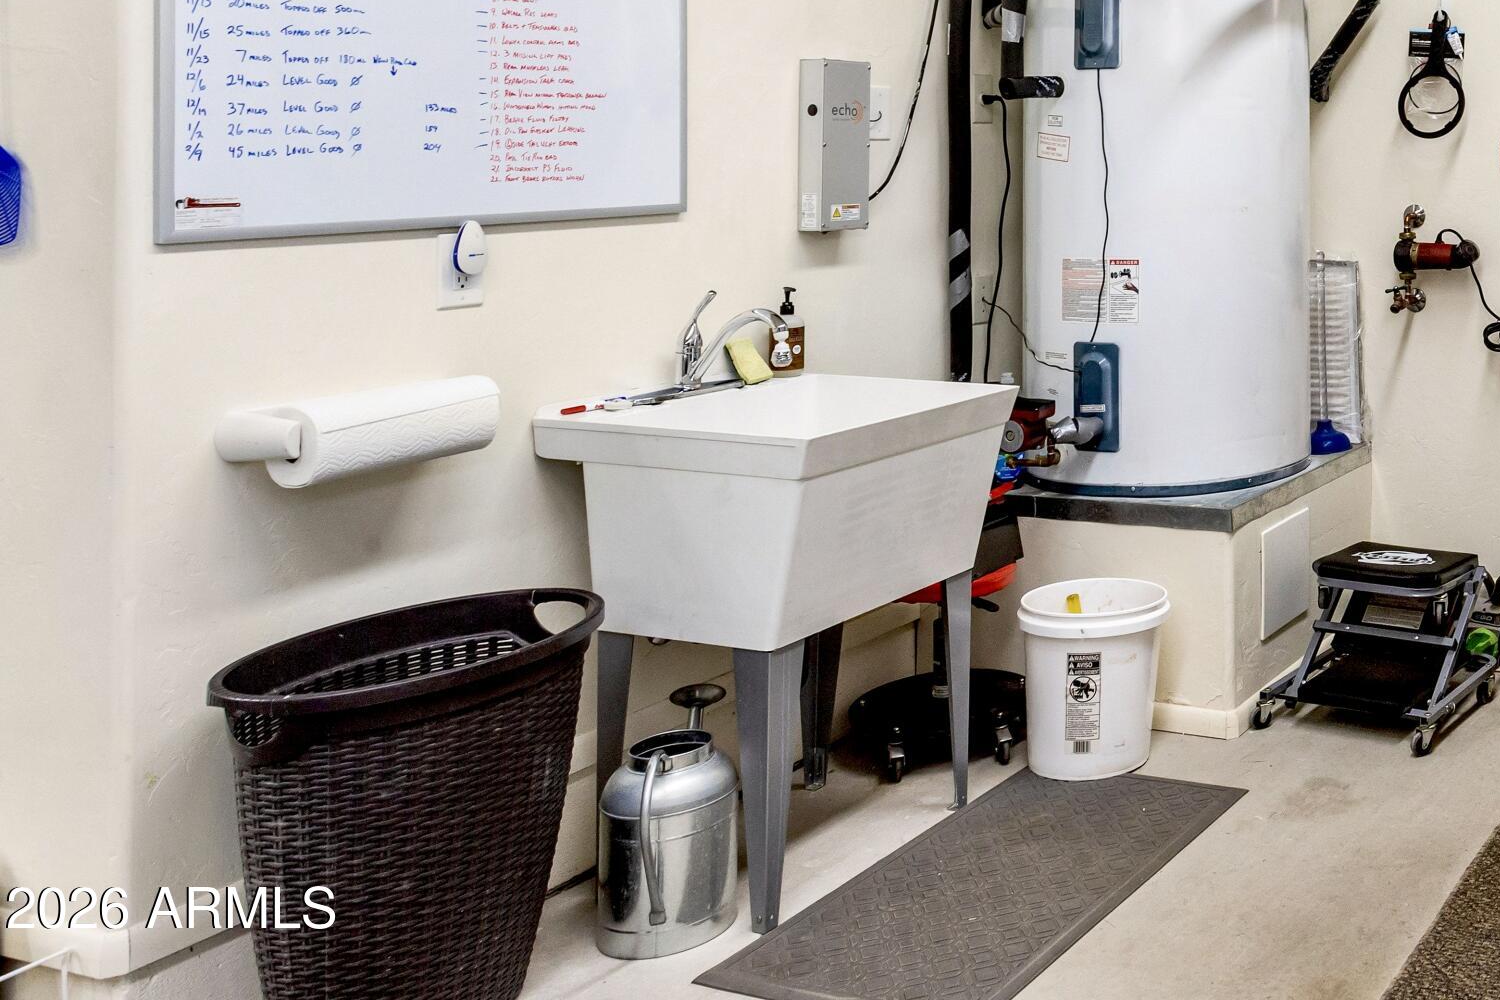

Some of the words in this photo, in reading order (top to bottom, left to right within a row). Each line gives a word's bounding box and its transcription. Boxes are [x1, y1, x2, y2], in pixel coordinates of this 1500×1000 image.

[186, 17, 210, 41] 11/15
[227, 25, 244, 36] 25
[186, 44, 210, 67] 11/23
[235, 49, 247, 63] 7
[186, 69, 206, 93] 12/6
[226, 74, 245, 85] 24
[283, 74, 311, 86] LEVEL
[316, 73, 338, 86] GOOD
[227, 103, 245, 116] 37
[283, 100, 307, 113] LEVEL
[831, 102, 858, 116] echo
[227, 124, 243, 136] 26
[228, 146, 244, 159] 45
[286, 145, 315, 156] LEVEL
